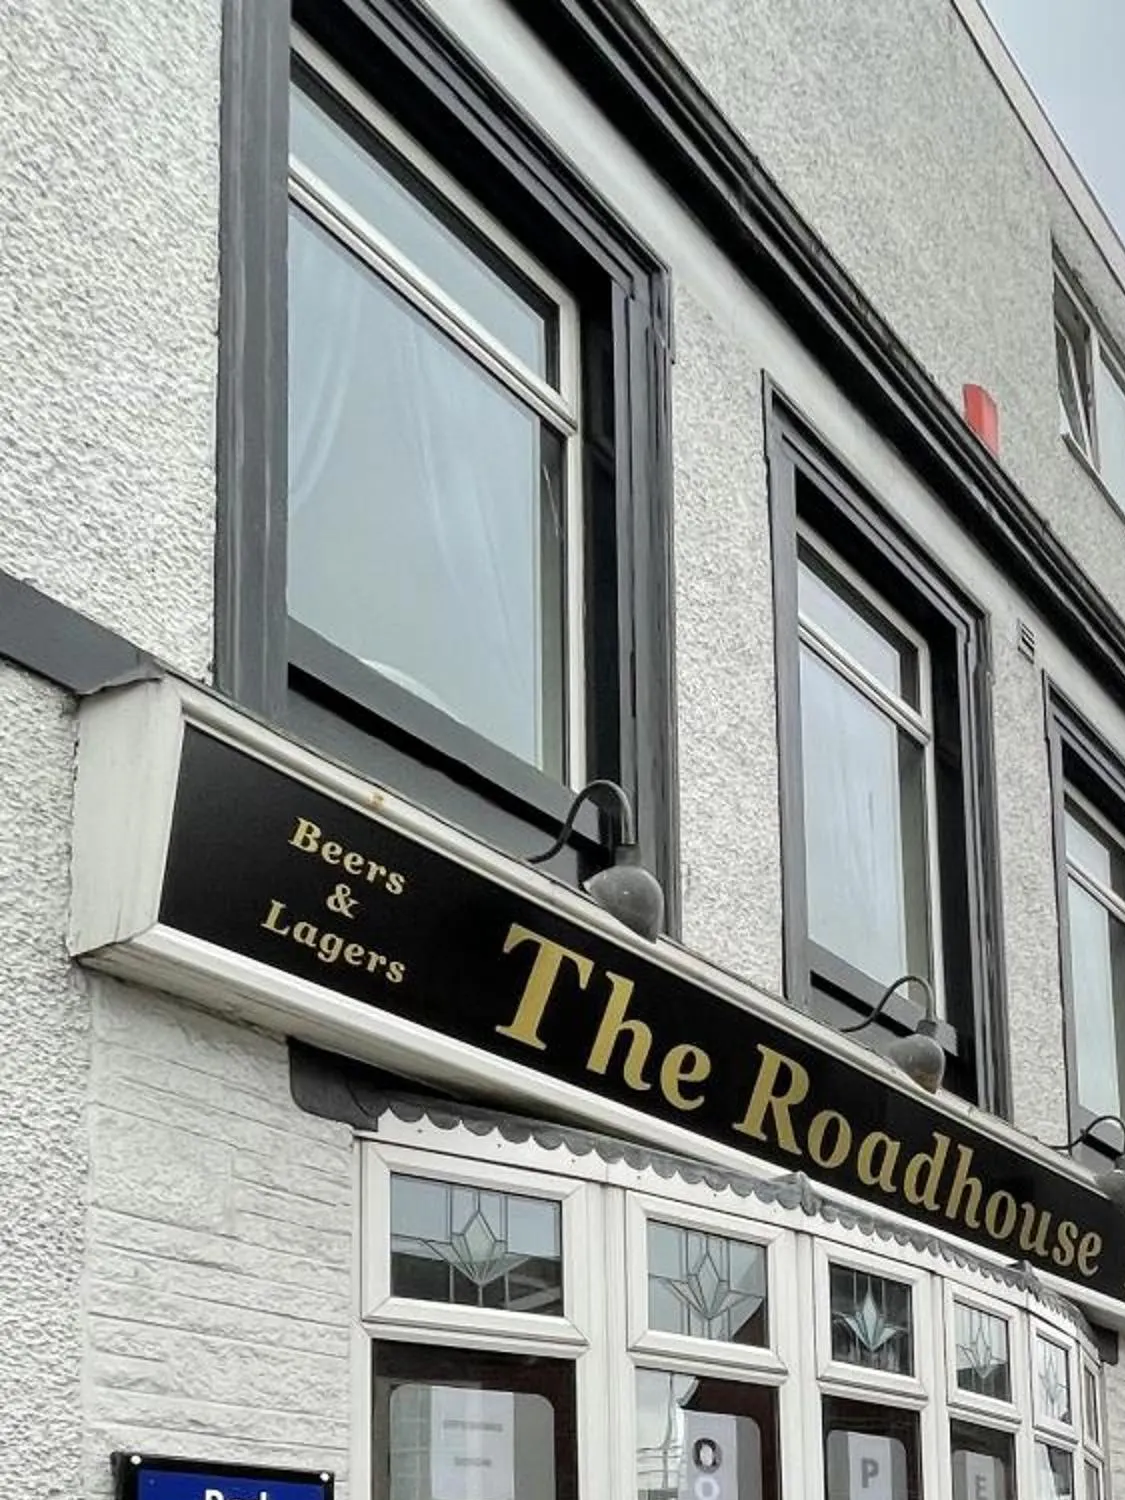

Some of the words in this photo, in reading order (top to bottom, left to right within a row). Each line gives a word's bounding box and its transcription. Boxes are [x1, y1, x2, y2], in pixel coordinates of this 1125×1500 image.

[288, 817, 408, 895] Beers
[261, 899, 407, 984] Lagers
[326, 884, 359, 920] &
[496, 922, 712, 1111] The
[732, 1043, 1103, 1278] Roadhouse
